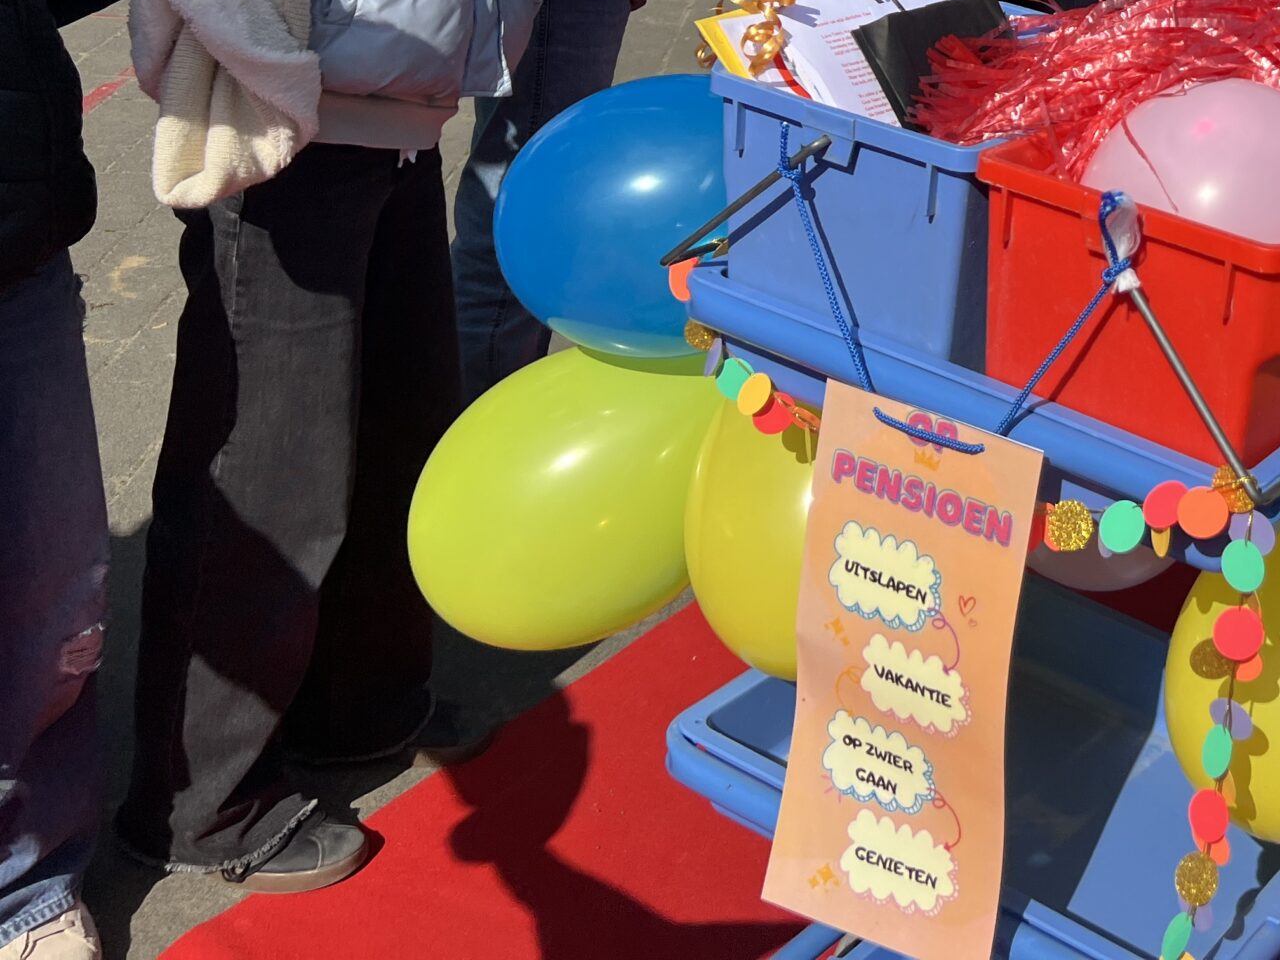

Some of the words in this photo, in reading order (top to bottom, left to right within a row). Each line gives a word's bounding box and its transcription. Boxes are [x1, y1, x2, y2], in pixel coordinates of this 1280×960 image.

[831, 448, 1013, 548] PENSIOEN
[844, 559, 928, 605] UITSLAPEN
[873, 663, 953, 709] VAKANTIE
[842, 734, 862, 751] OP
[865, 742, 915, 775] ZWIER
[855, 767, 898, 796] GAAN
[854, 846, 938, 890] GENIETEN
